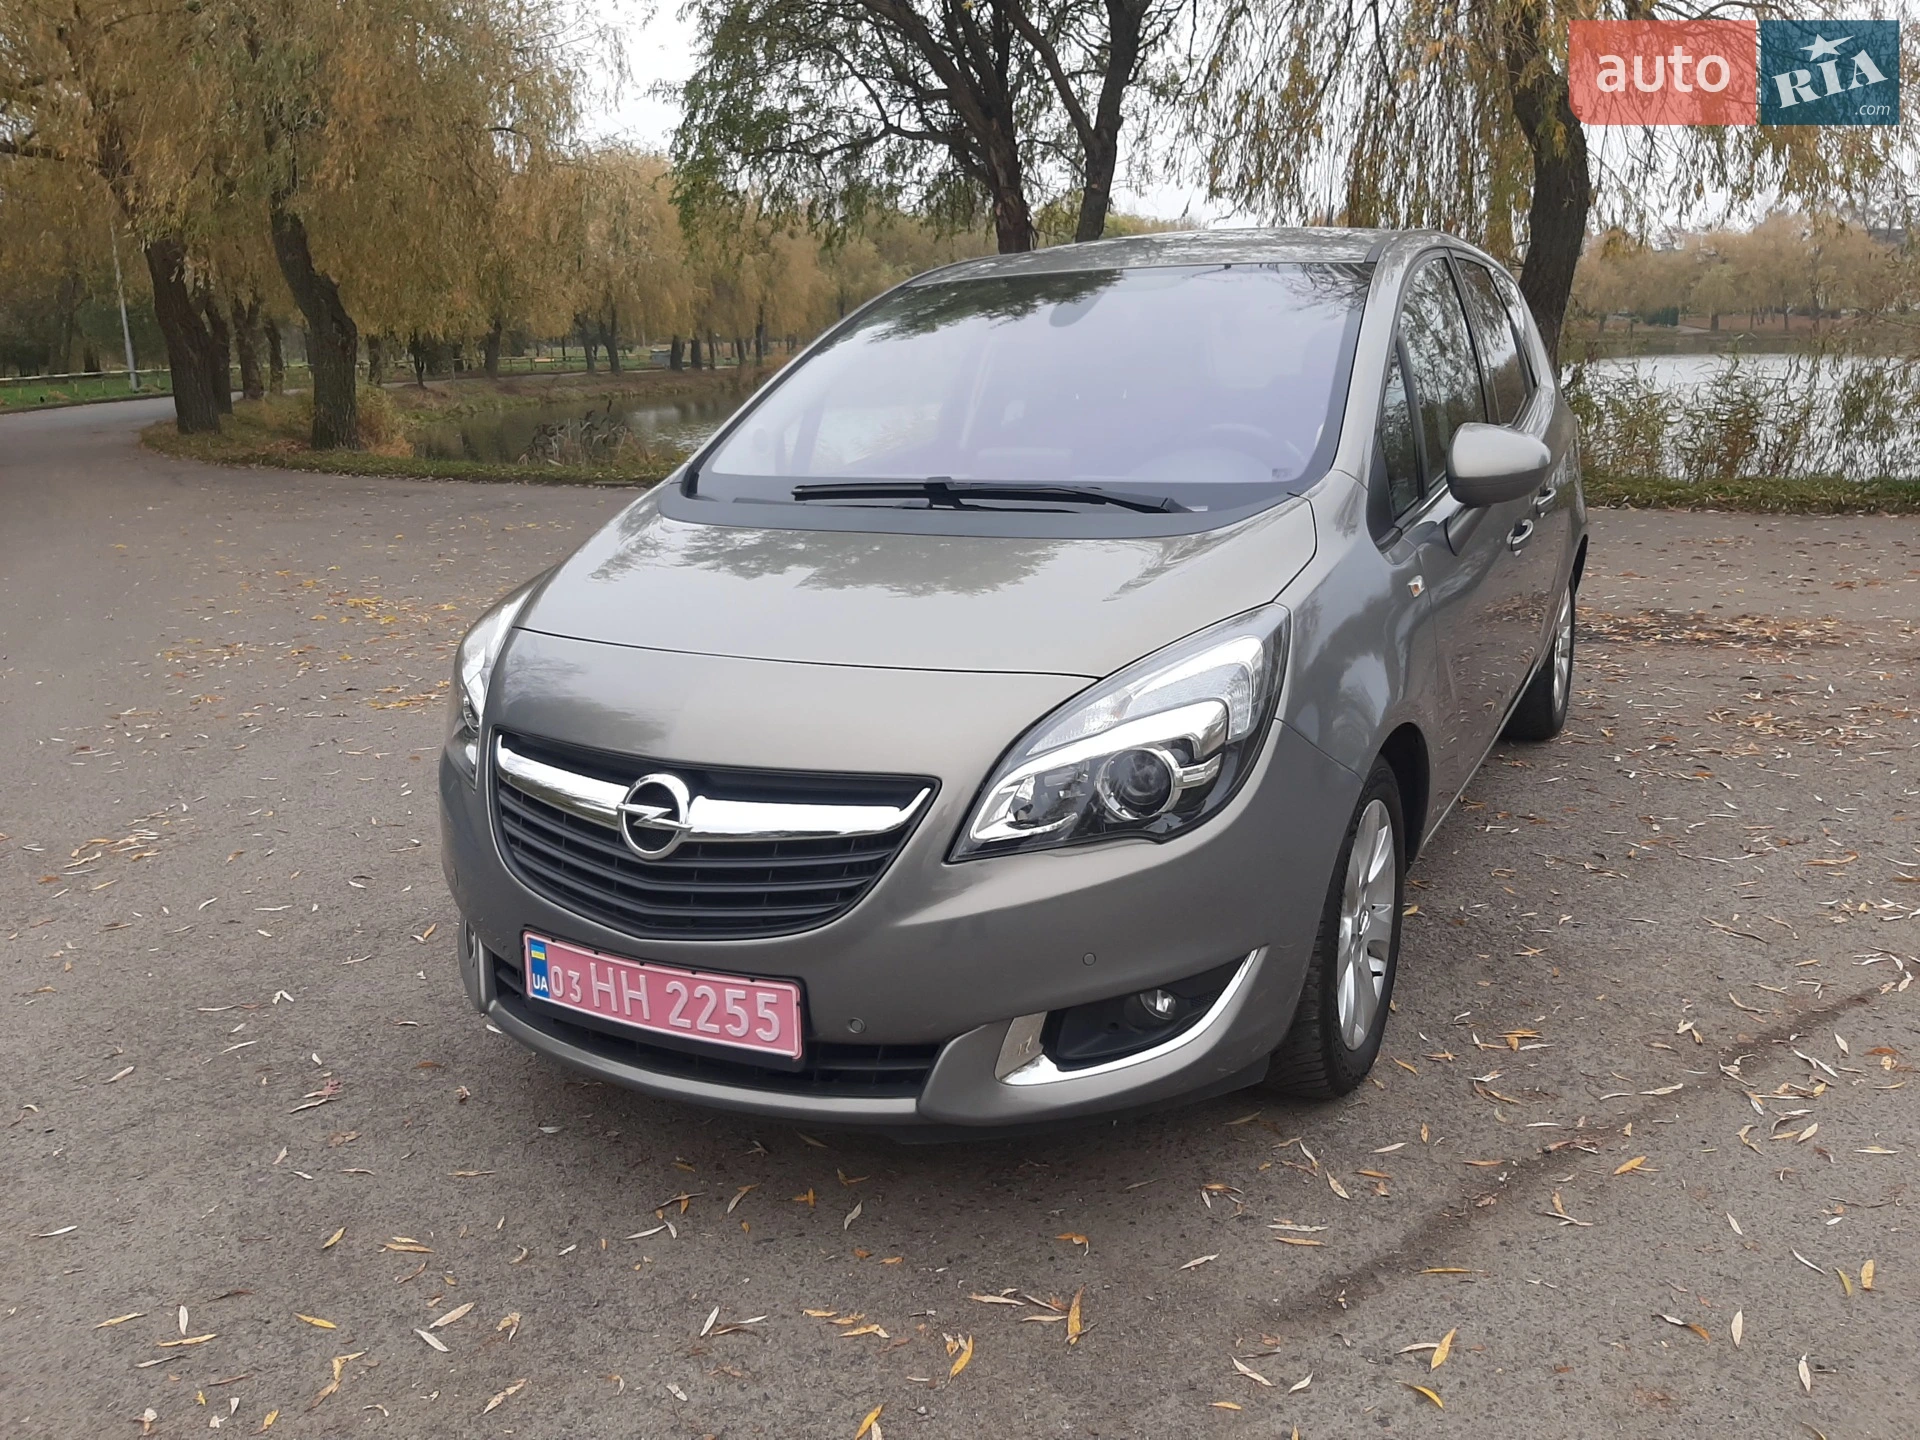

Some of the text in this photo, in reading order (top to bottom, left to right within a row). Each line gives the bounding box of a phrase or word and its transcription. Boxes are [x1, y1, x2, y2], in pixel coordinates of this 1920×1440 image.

[533, 974, 549, 991] UA
[550, 963, 780, 1041] 03 HH 2255
